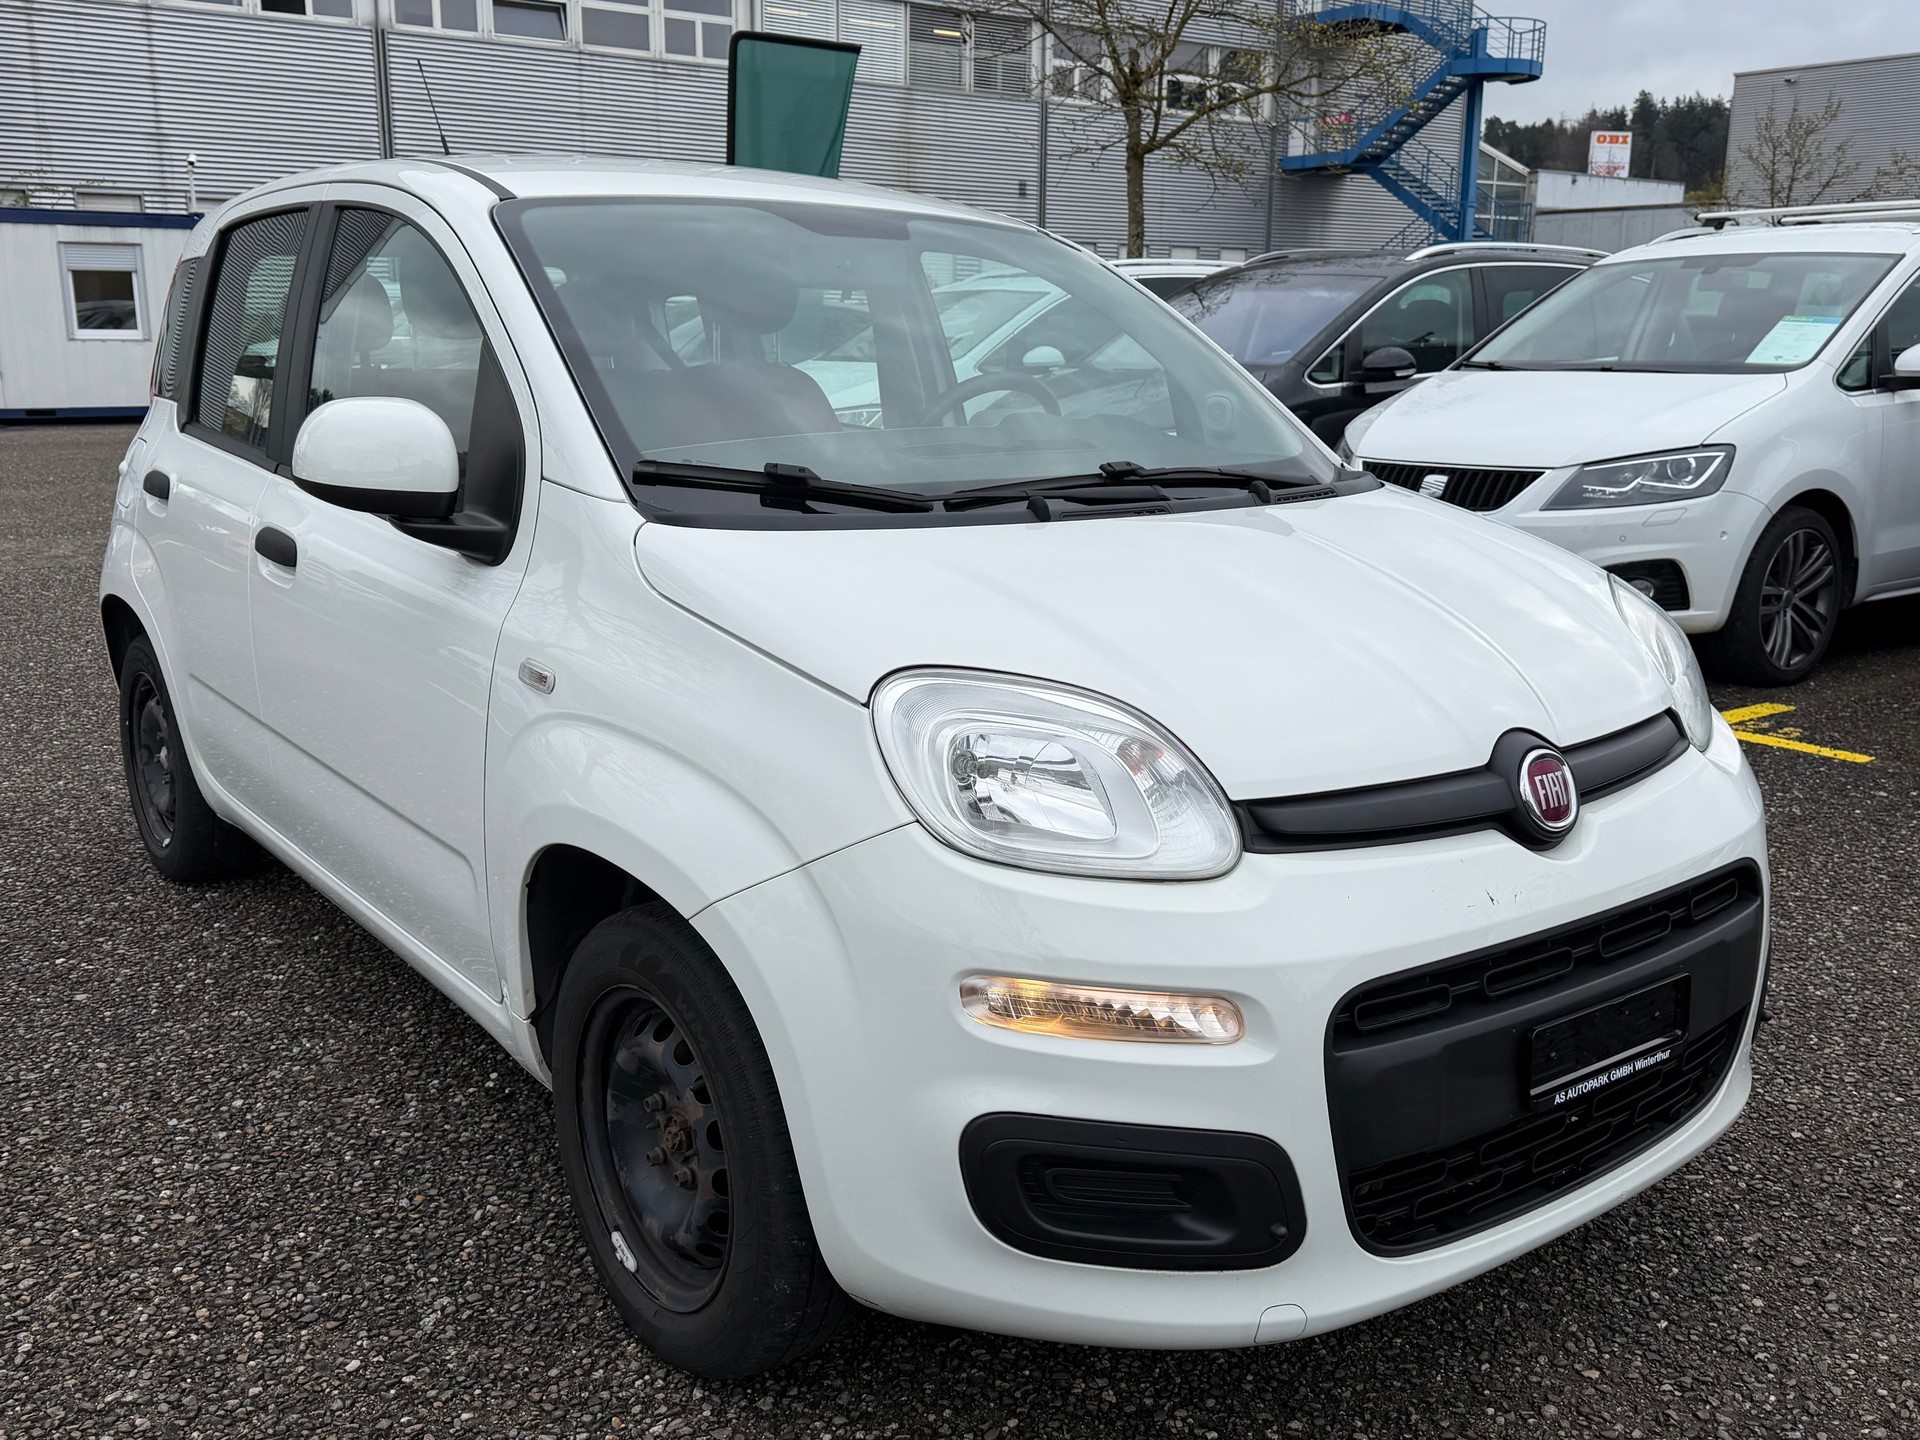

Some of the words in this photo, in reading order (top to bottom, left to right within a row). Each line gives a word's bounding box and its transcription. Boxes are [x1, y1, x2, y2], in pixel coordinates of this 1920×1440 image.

[1596, 134, 1629, 145] OBI
[1534, 770, 1568, 810] FIAT
[1554, 1091, 1566, 1105] AS
[1566, 1073, 1609, 1100] AUTOPARK
[1610, 1062, 1634, 1082] GMBH
[1635, 1049, 1671, 1071] Winterthur
